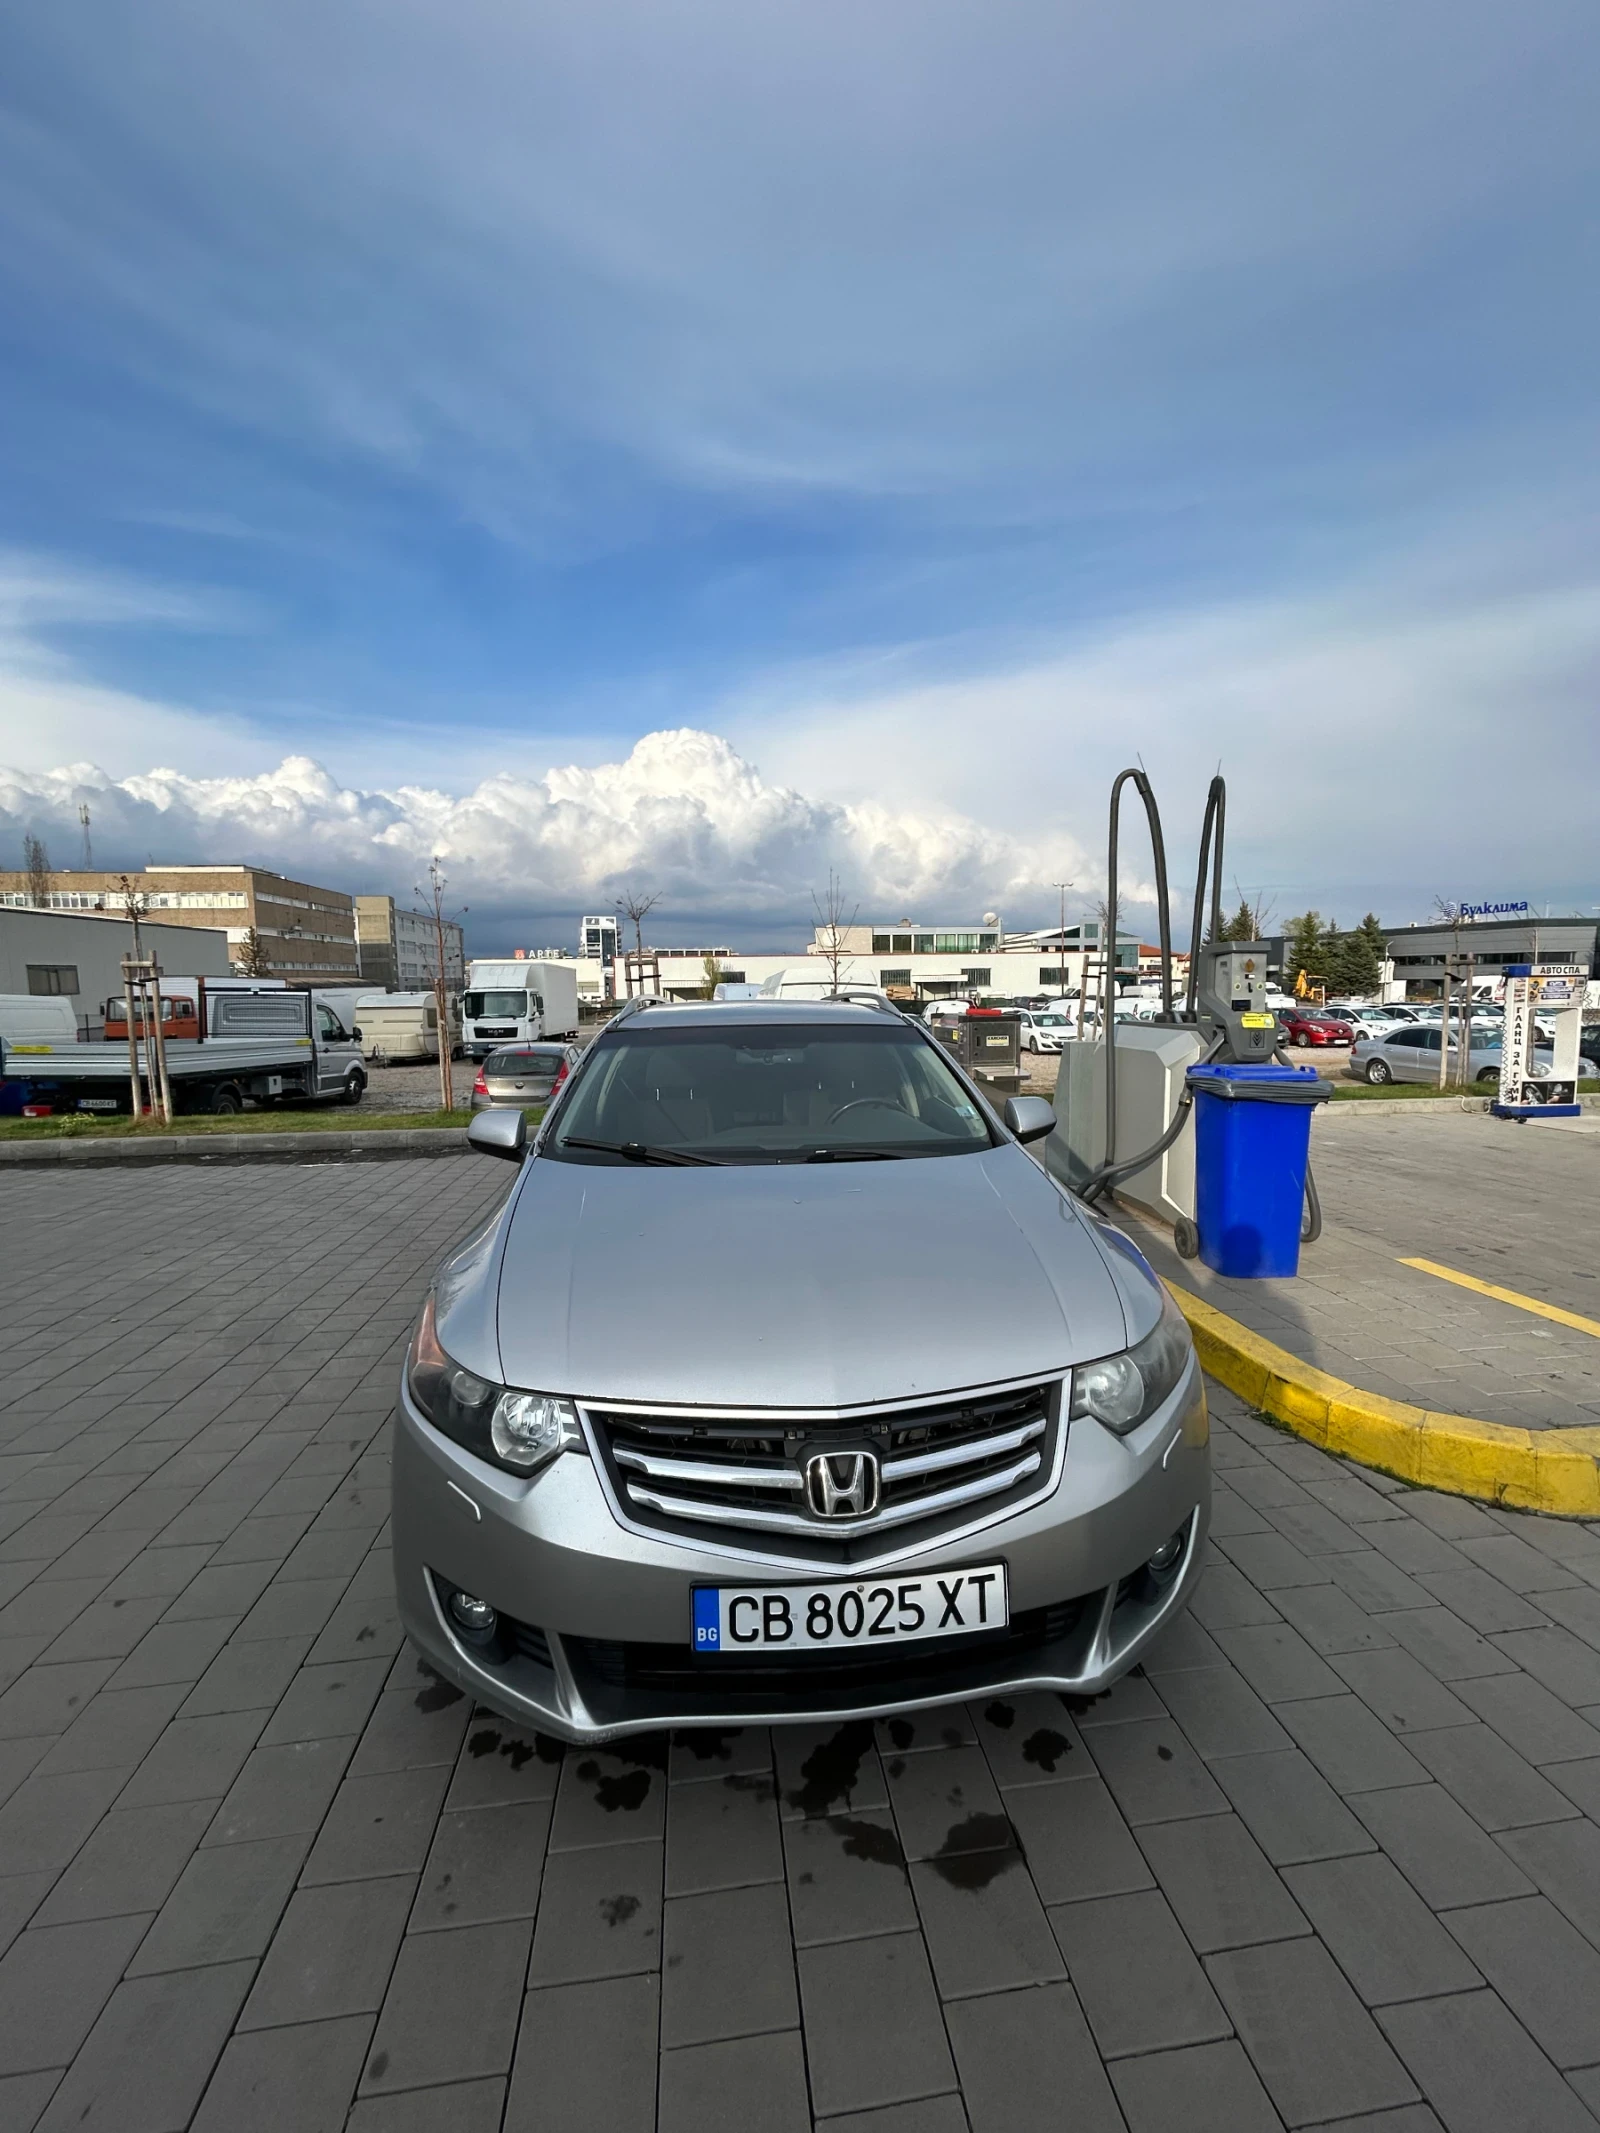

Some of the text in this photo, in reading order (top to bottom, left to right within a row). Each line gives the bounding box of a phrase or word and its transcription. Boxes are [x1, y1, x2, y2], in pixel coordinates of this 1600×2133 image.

[1460, 901, 1528, 918] Булклима
[528, 949, 560, 959] ARTE
[1540, 966, 1580, 974] АВТО СПА
[1510, 1006, 1523, 1102] ГЛАНЦ ЗА ГУМИ
[728, 1573, 996, 1642] CB 8025 XT
[697, 1627, 717, 1642] BG
